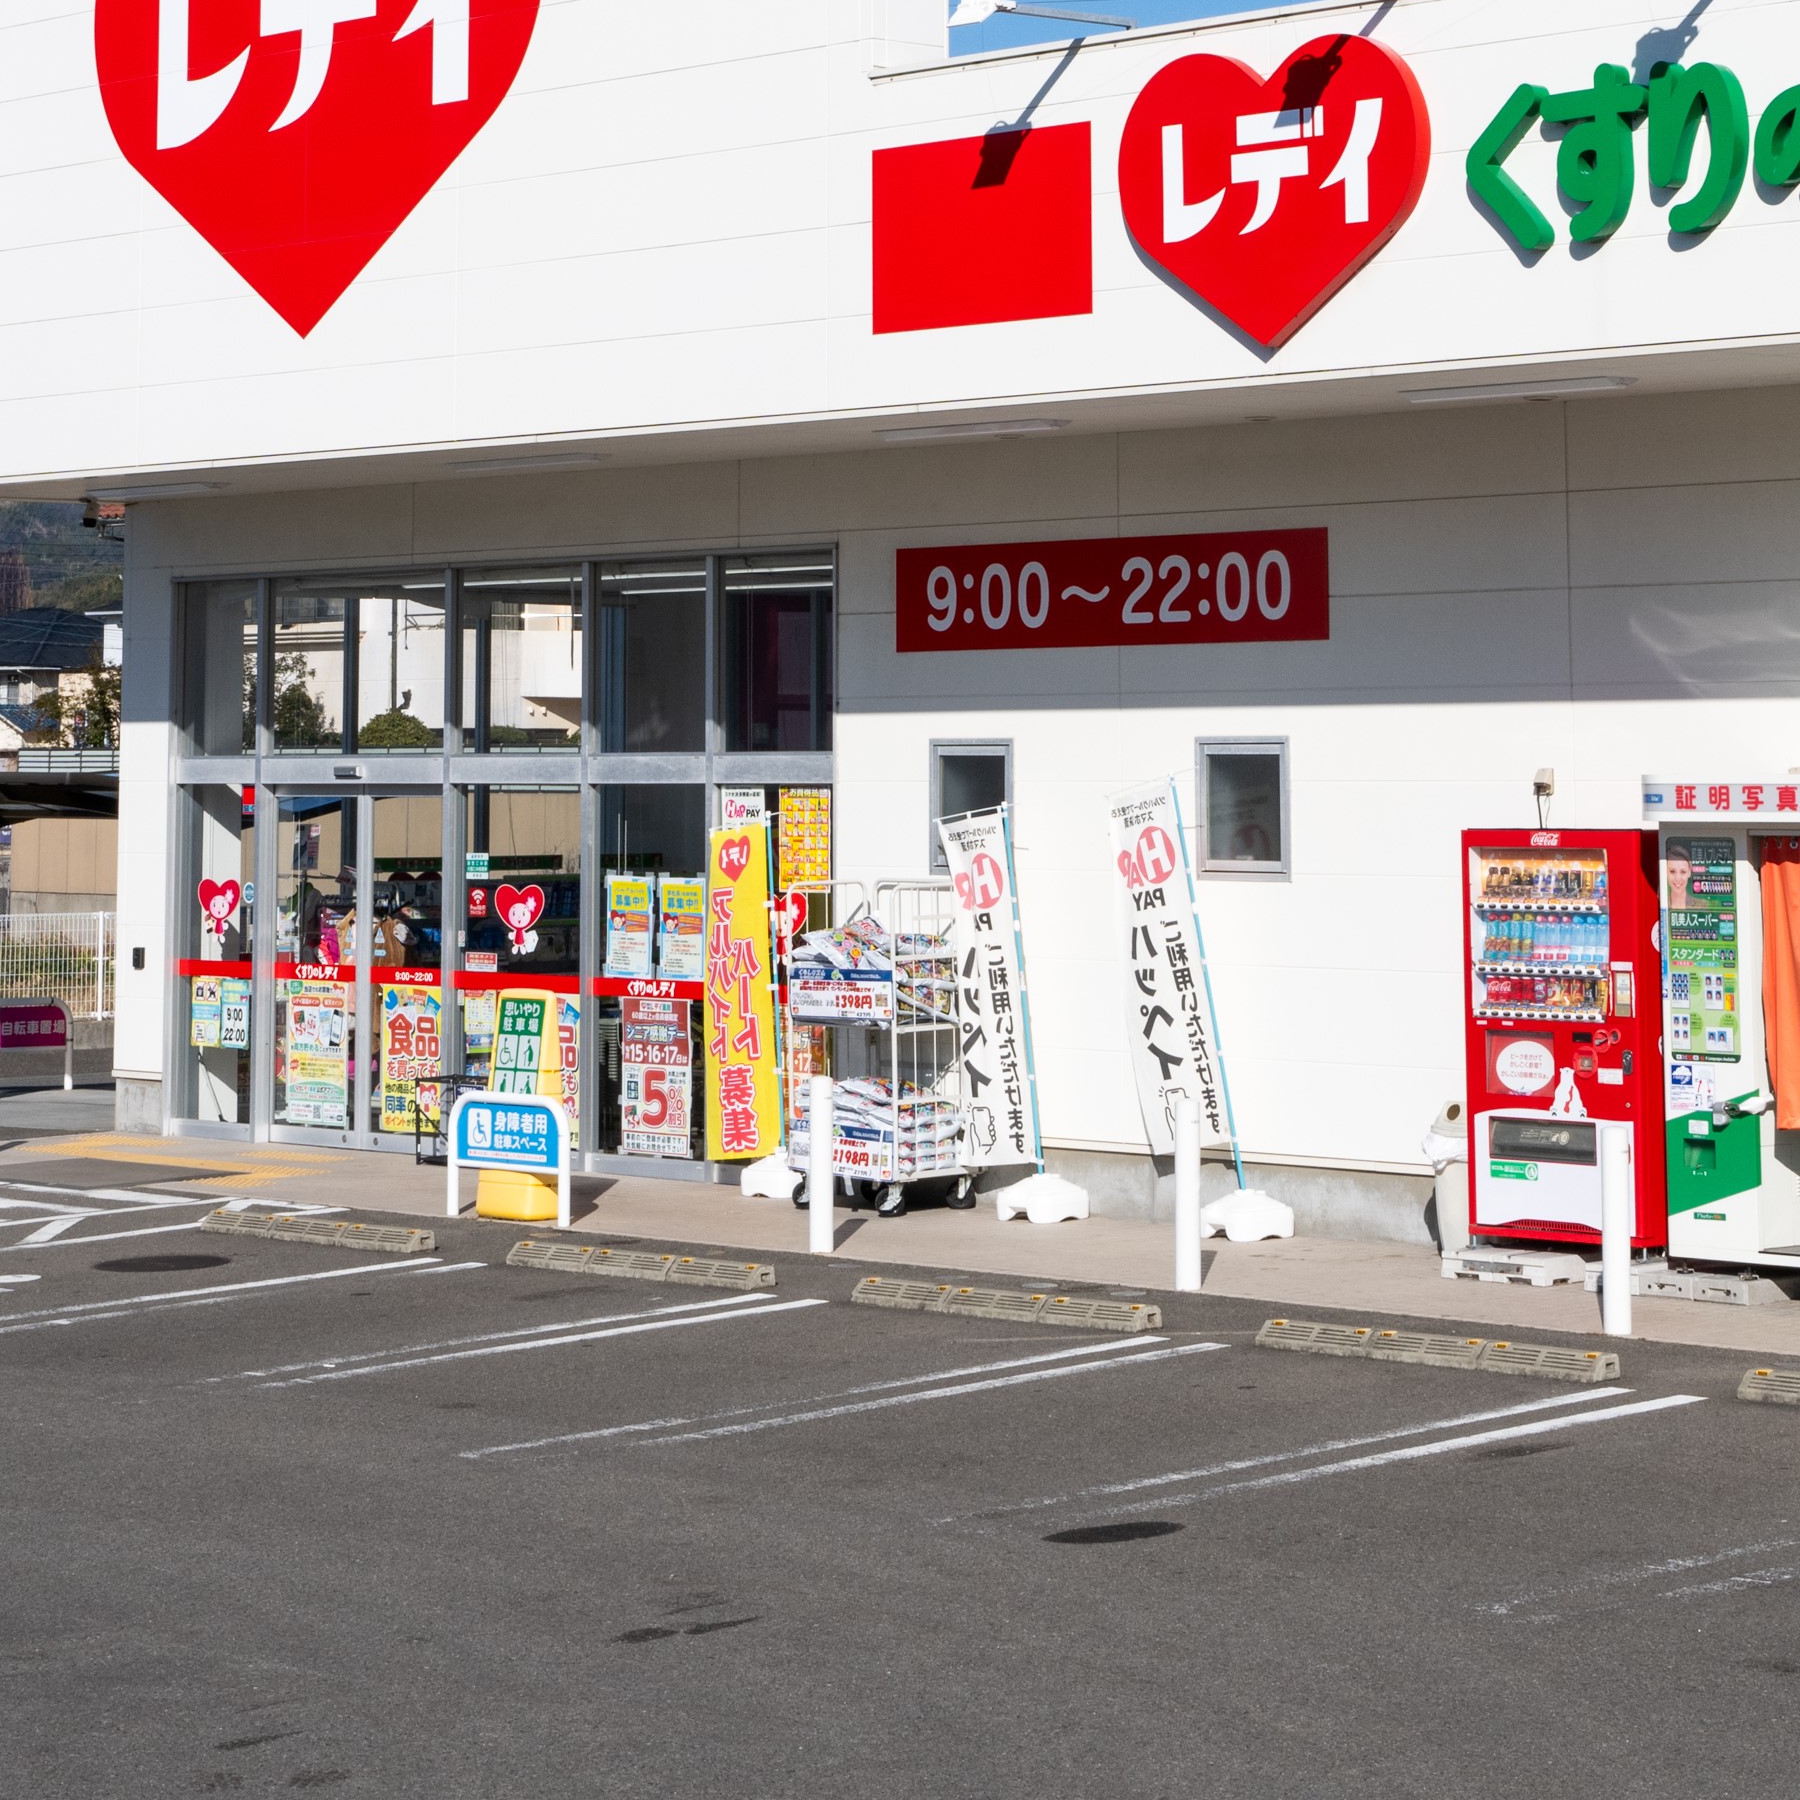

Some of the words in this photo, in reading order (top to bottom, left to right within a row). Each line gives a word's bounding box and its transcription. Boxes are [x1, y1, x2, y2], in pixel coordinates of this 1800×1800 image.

[1161, 97, 1384, 244] レディ
[926, 549, 1292, 632] 9:00～22:00
[1675, 785, 1799, 811] 証明写真
[1671, 912, 1719, 927] 肌美人スーパー
[1672, 948, 1719, 961] スタンダード
[295, 964, 339, 980] くすりのレディ
[627, 980, 676, 997] くすりのレディ
[504, 1001, 541, 1016] 思いやり
[841, 994, 873, 1009] 398円
[226, 1007, 243, 1022] 9:00
[1, 1018, 66, 1037] 自転車置場
[503, 1018, 539, 1033] 駐車場
[626, 1023, 687, 1043] シニア感謝デー
[223, 1028, 245, 1042] 22:00
[387, 1012, 440, 1059] 食品
[386, 1060, 440, 1080] を買っても
[494, 1111, 548, 1135] 身障者用
[494, 1134, 548, 1152] 駐車スペース
[839, 1149, 869, 1167] 198円
